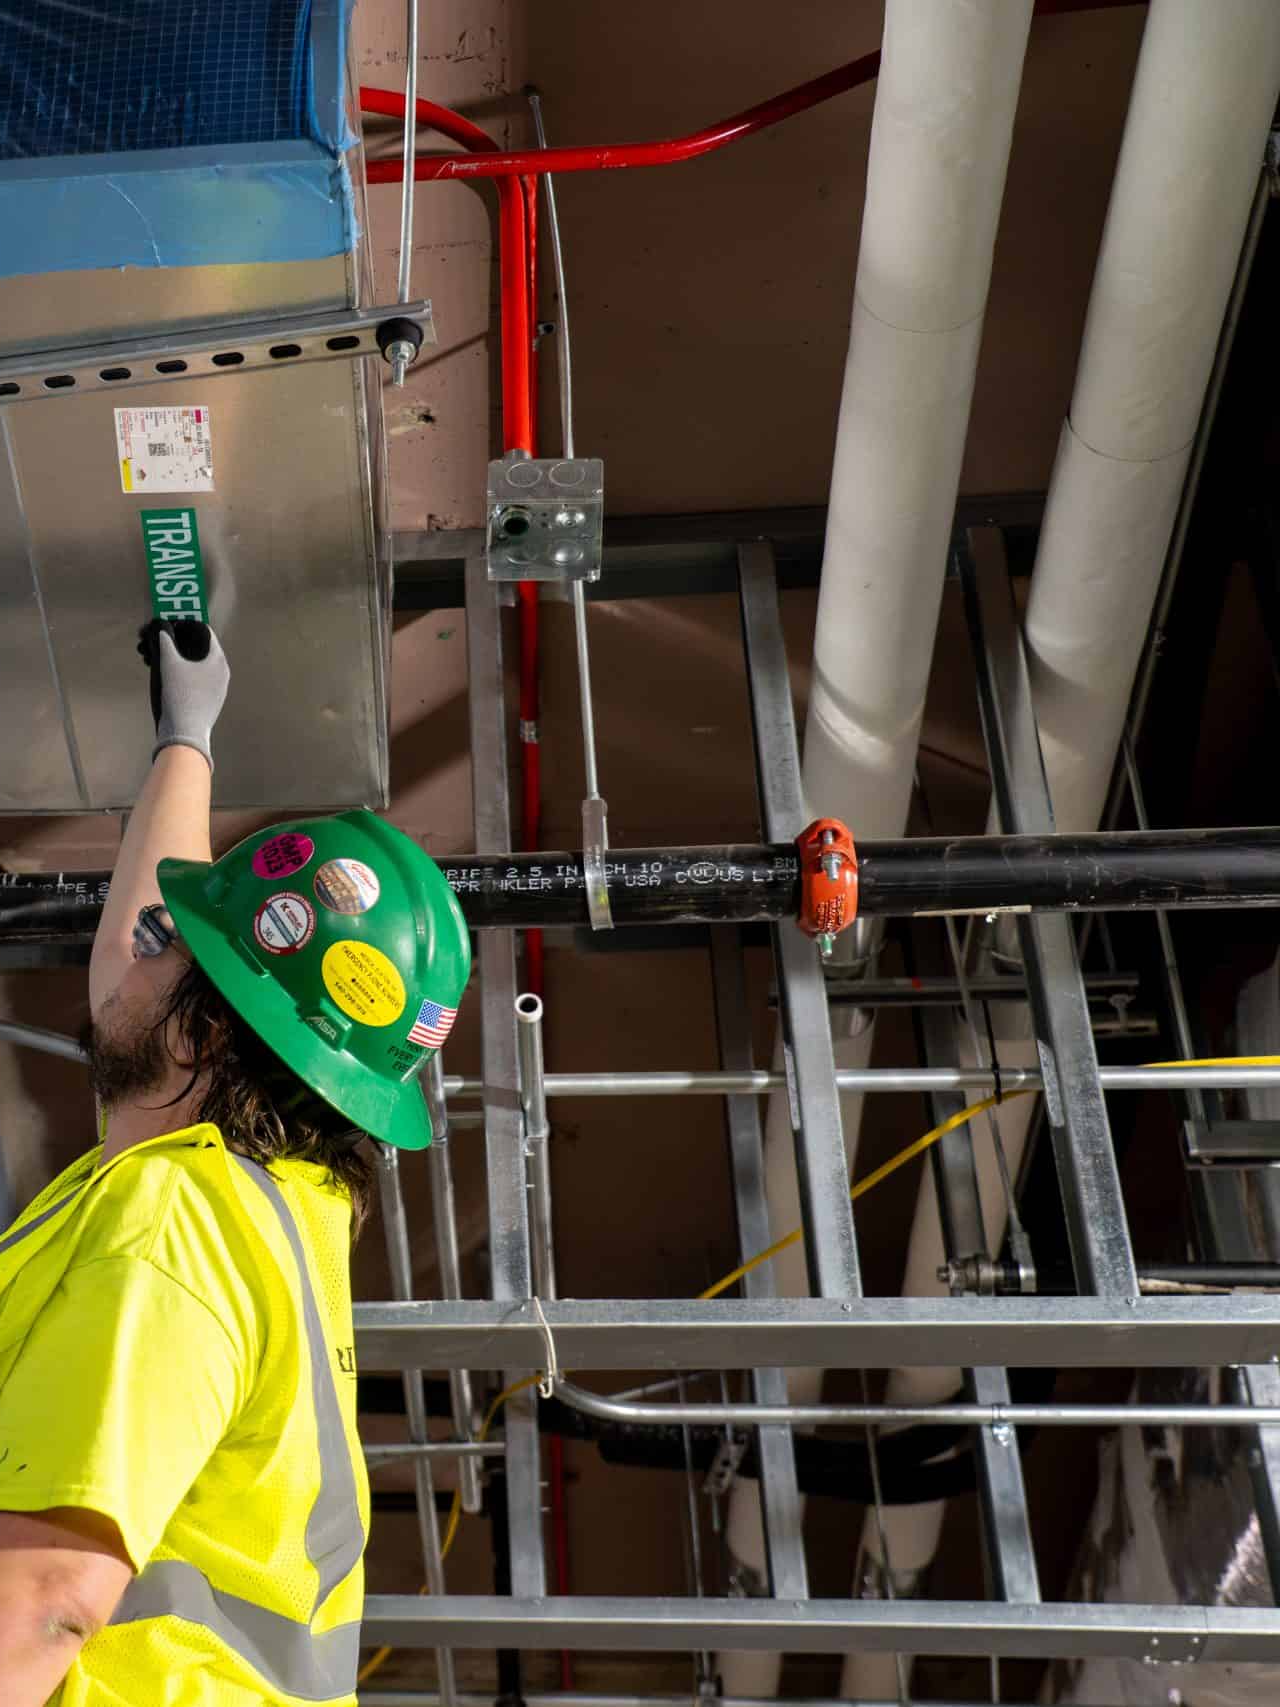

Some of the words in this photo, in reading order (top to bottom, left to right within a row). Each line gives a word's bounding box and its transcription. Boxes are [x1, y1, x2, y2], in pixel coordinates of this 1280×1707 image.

[506, 866, 542, 879] 2.5
[556, 865, 578, 877] IN
[641, 862, 663, 874] 10
[448, 878, 553, 893] SPRNKLER
[624, 874, 661, 887] USA
